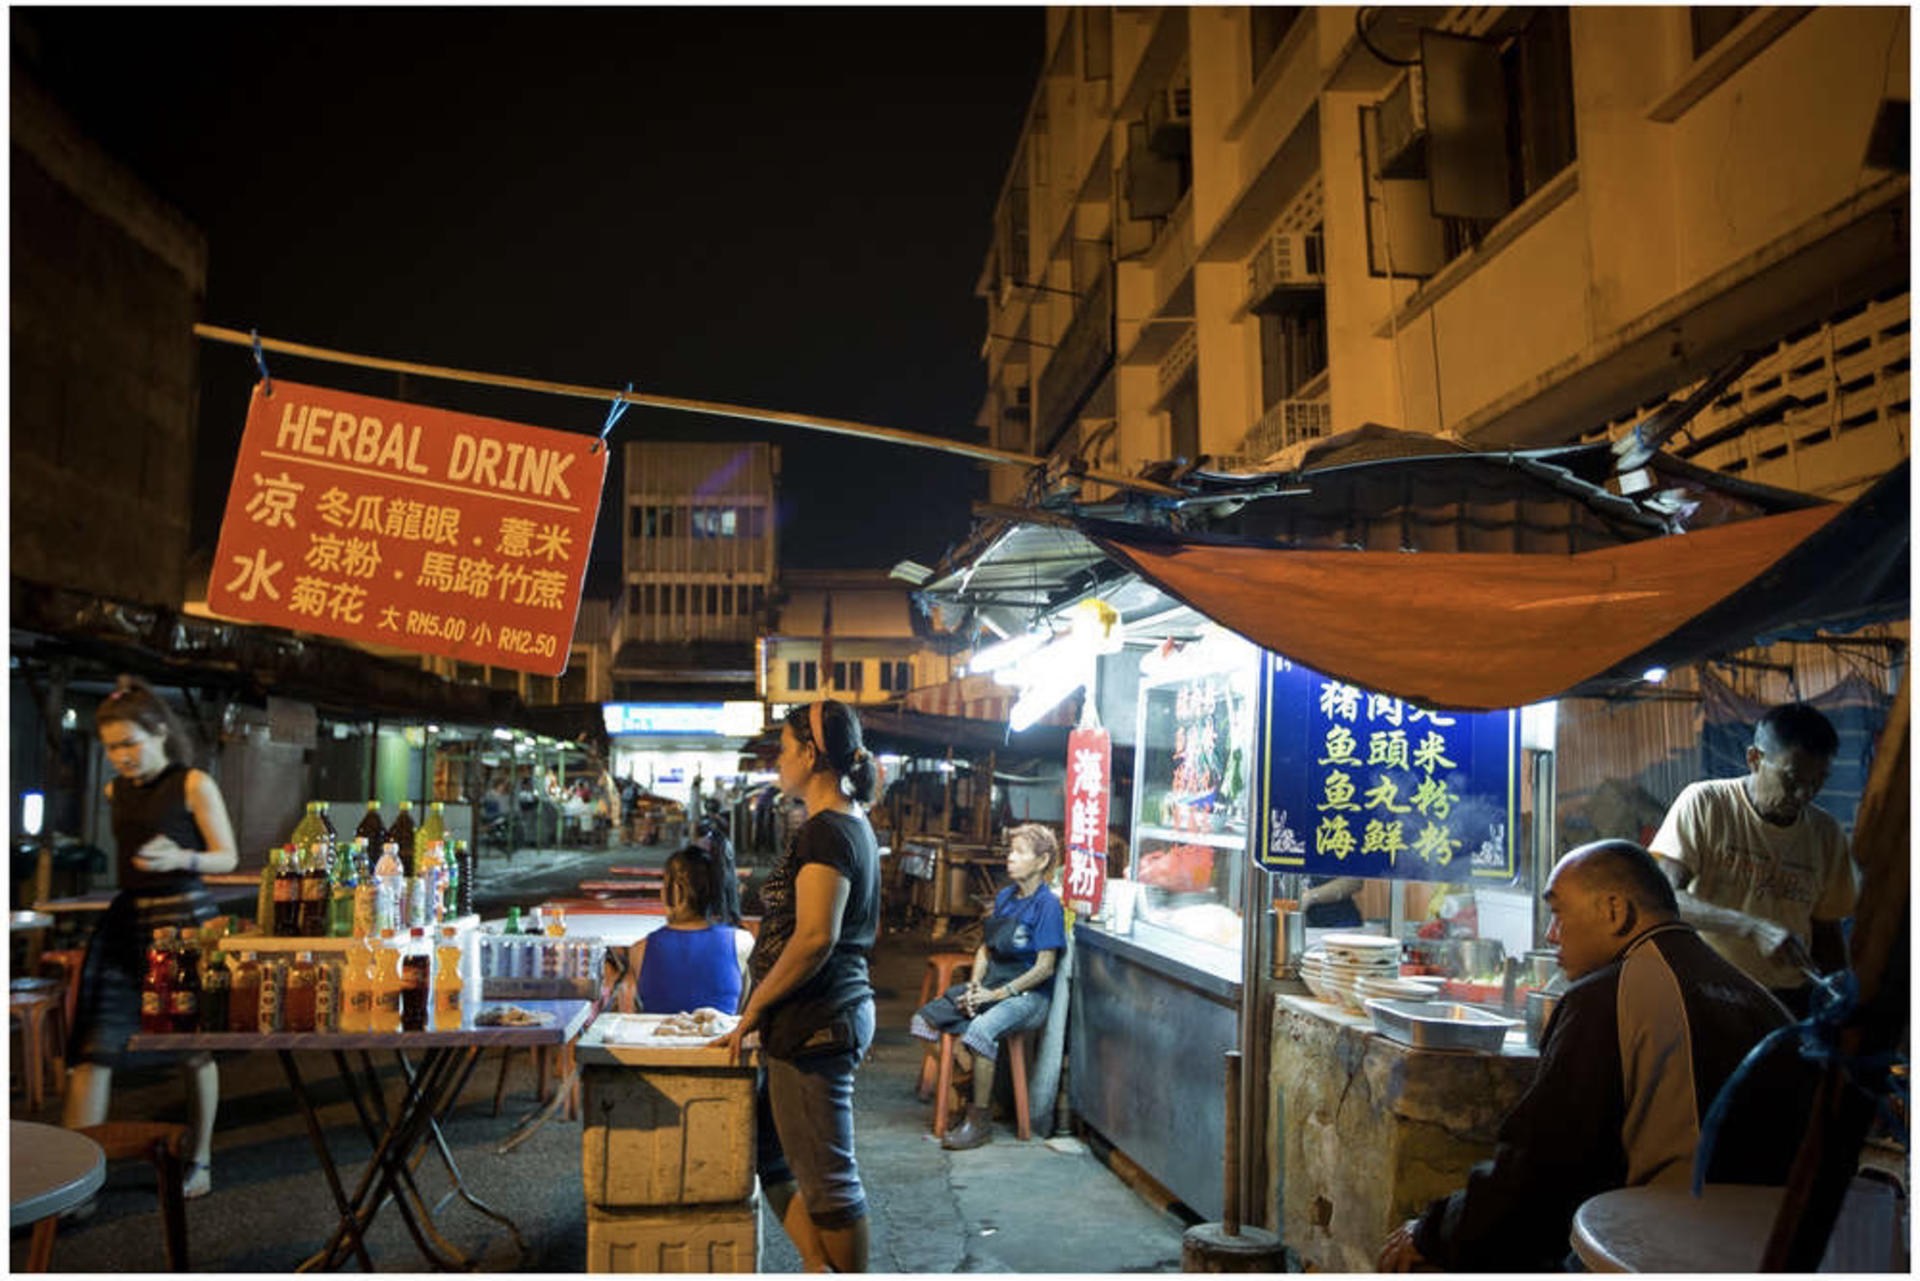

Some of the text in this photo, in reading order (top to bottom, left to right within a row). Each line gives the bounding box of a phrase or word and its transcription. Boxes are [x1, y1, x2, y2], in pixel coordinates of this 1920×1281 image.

[272, 403, 575, 499] HERBAL DRINK
[406, 610, 466, 641] RM5.00
[498, 627, 558, 657] RM2.50
